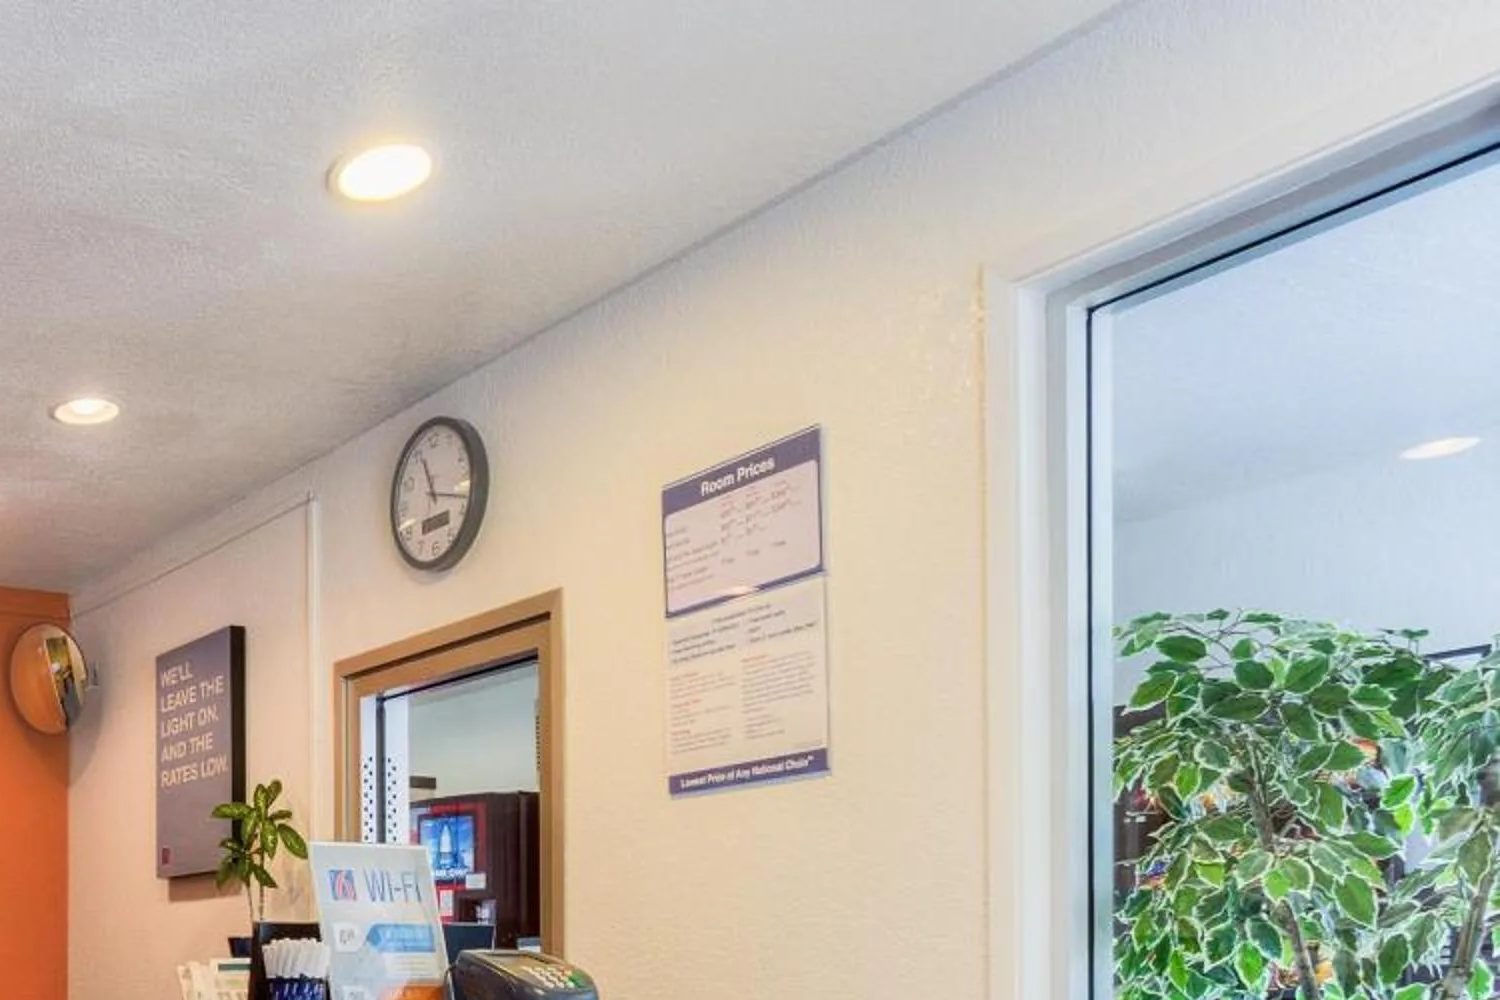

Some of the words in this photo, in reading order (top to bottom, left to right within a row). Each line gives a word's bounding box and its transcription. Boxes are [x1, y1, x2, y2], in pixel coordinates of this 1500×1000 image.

[701, 474, 735, 497] Room
[736, 457, 775, 482] Prices
[160, 661, 193, 687] WE'LL
[161, 684, 197, 712] LEAVE
[199, 675, 224, 699] THE
[161, 712, 197, 738] LIGHT
[161, 740, 187, 763] AND
[189, 732, 213, 753] THE
[161, 763, 198, 788] RATES
